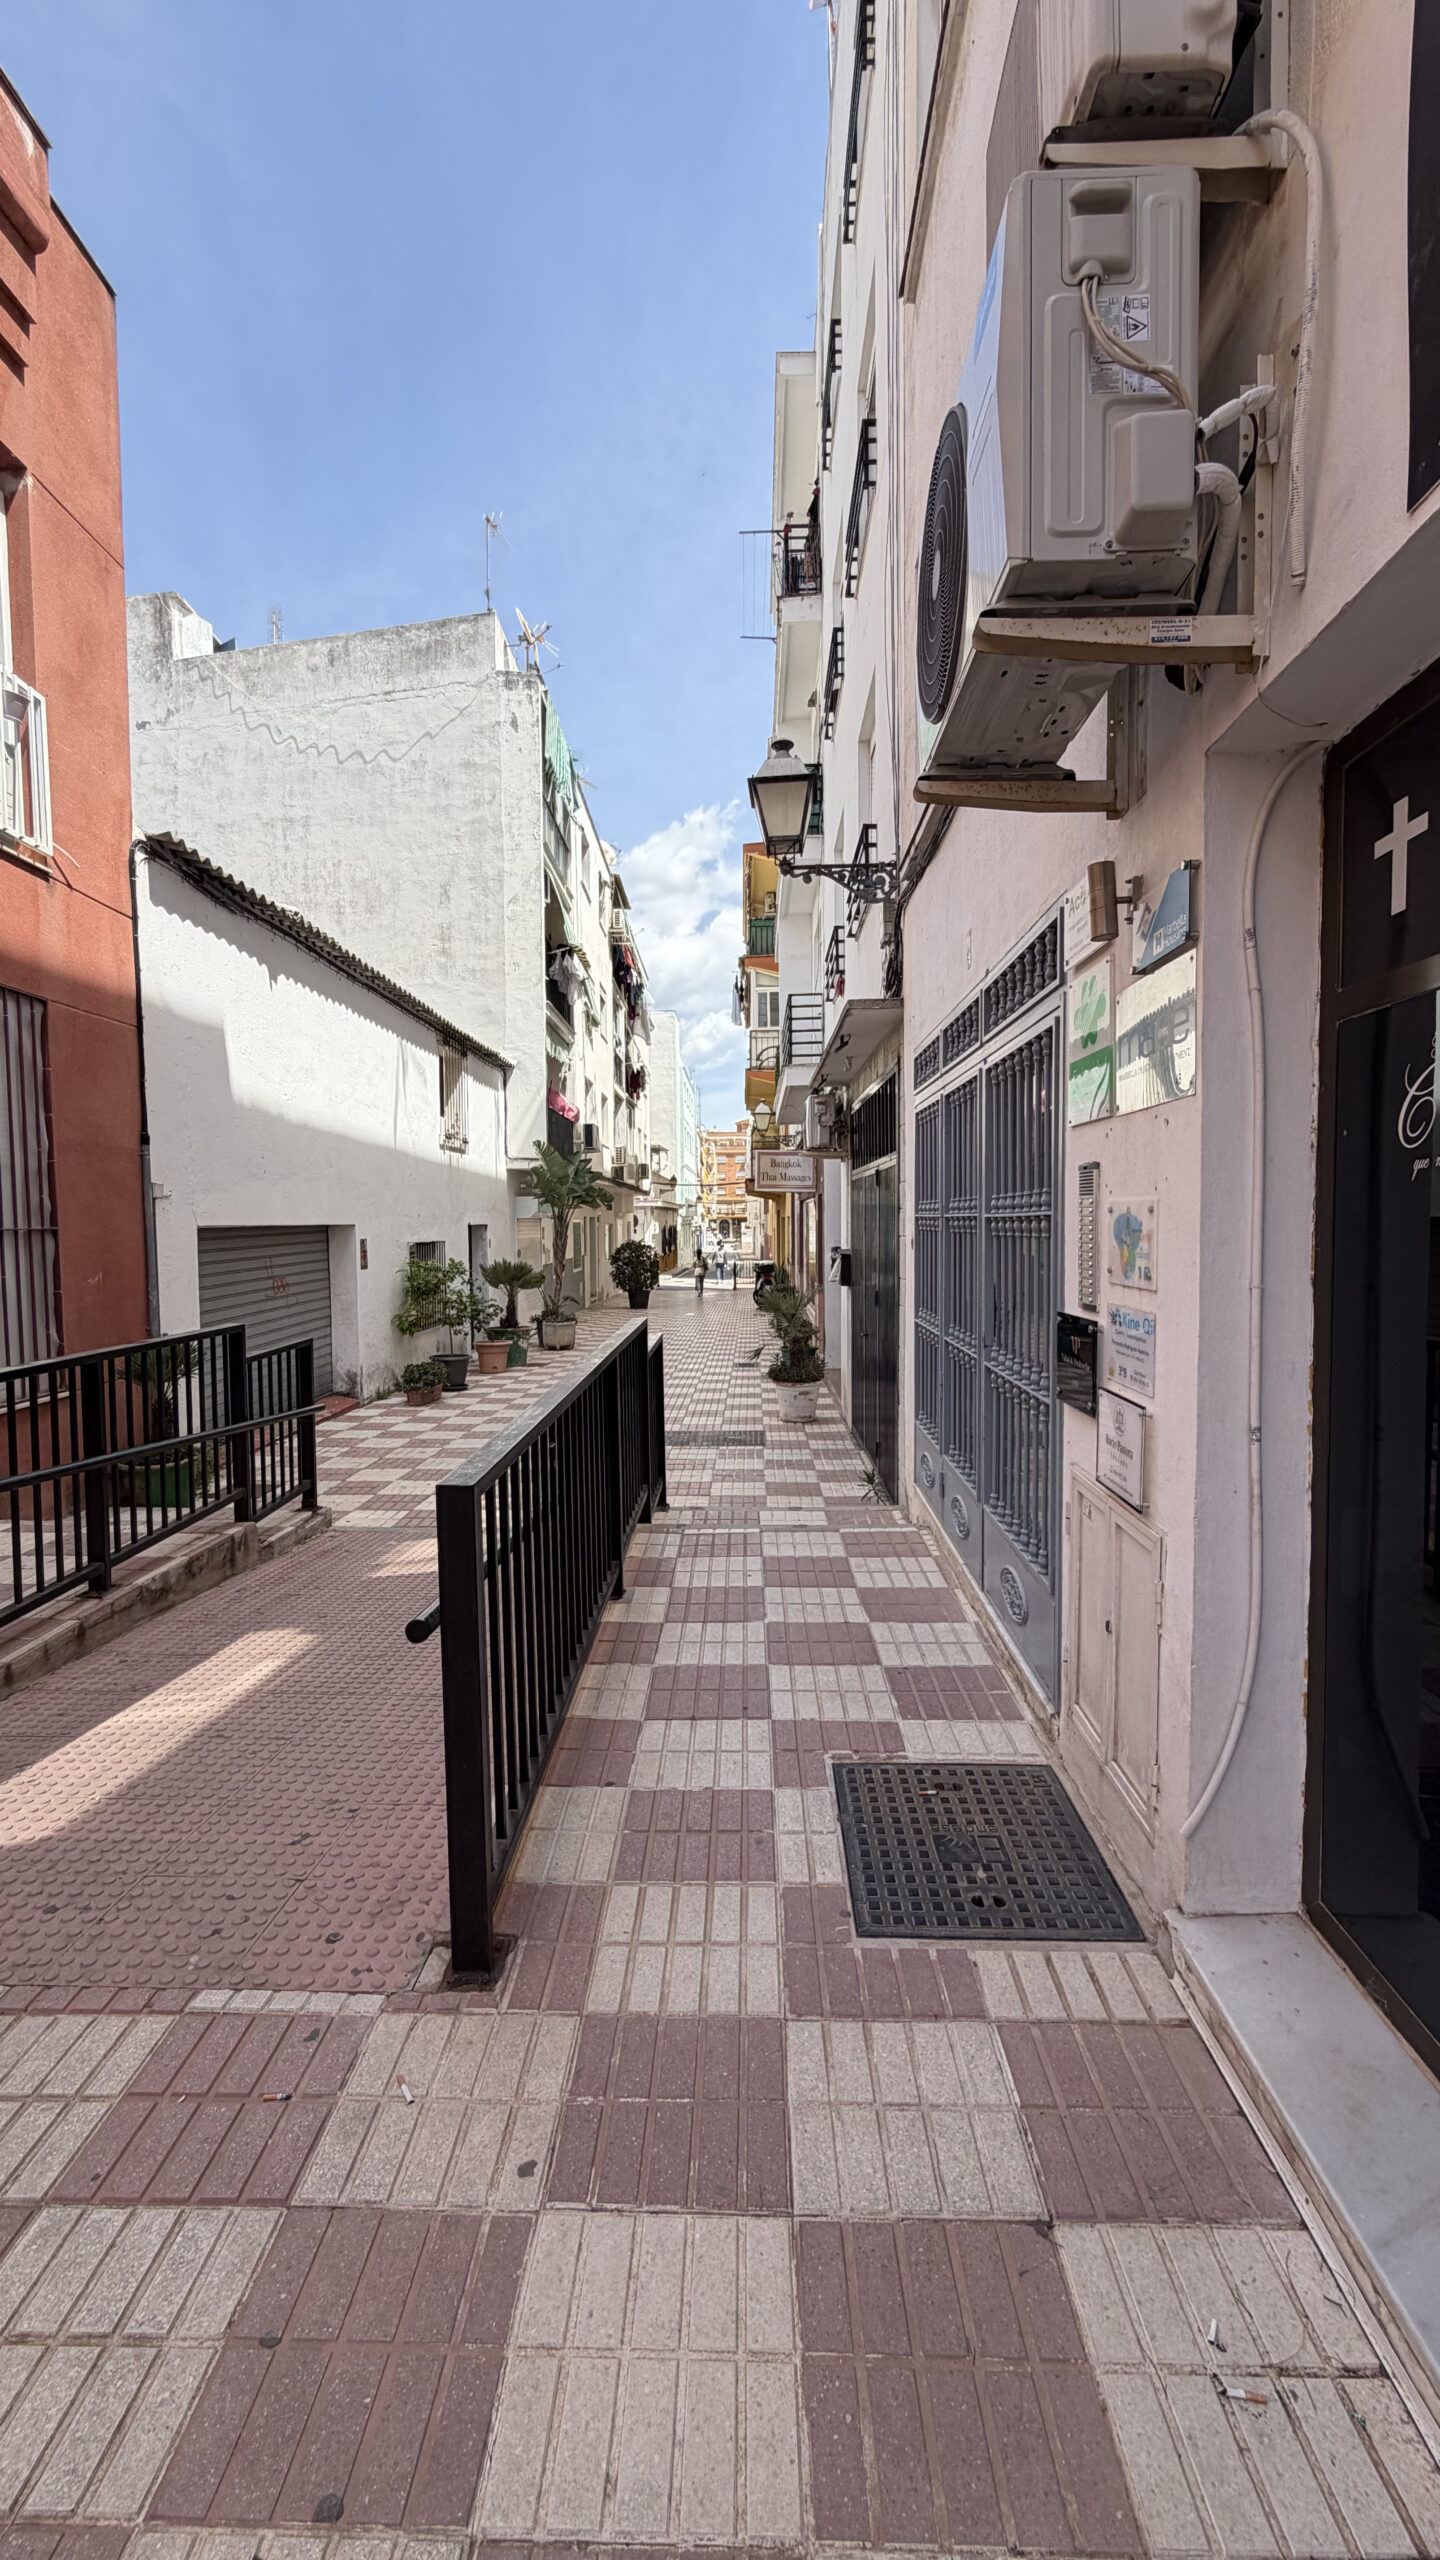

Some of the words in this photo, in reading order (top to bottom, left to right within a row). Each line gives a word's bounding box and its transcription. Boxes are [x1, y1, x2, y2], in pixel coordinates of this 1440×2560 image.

[770, 1158, 802, 1169] Bangkok
[760, 1172, 777, 1181] Thai
[779, 1172, 812, 1183] Massages
[1122, 1312, 1140, 1332] Kine
[930, 1824, 999, 1834] endesa
